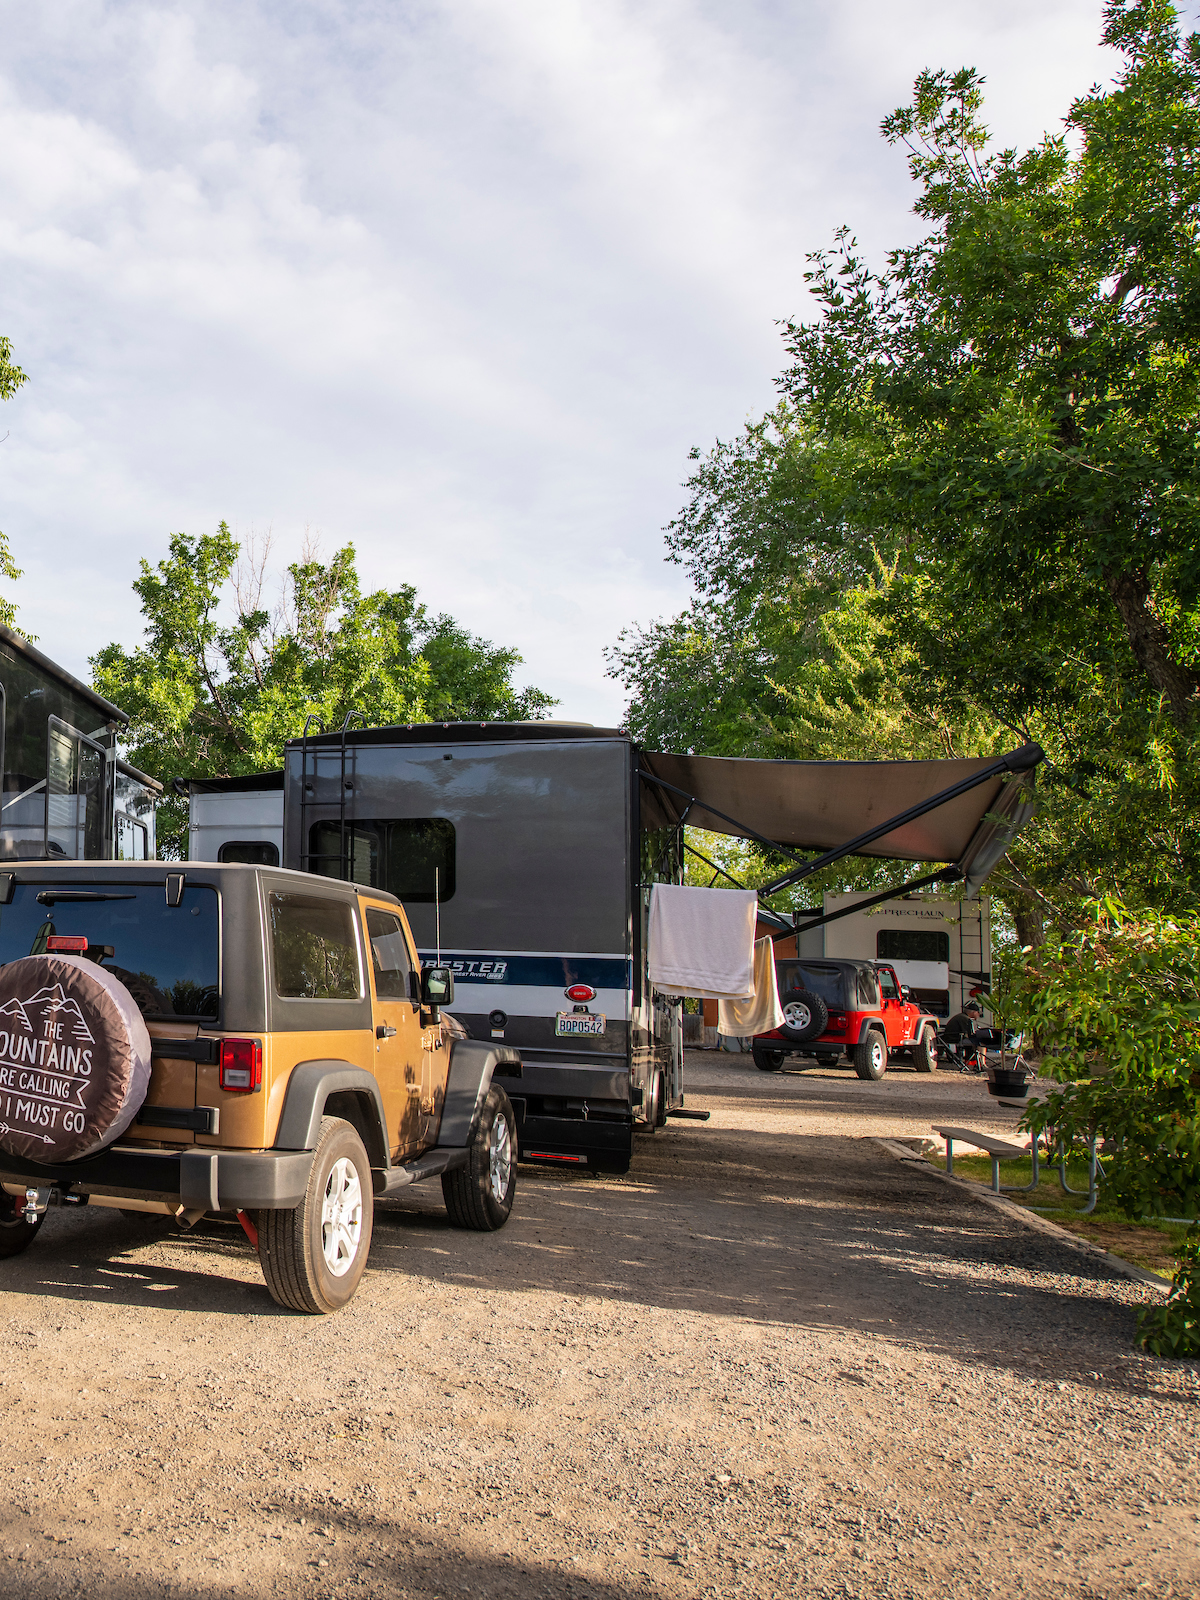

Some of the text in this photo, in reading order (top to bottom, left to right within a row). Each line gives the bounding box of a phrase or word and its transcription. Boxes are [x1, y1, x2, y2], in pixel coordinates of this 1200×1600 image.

[873, 908, 944, 917] EPRECHAUN
[419, 960, 507, 973] RESTER
[43, 1020, 64, 1040] THE
[19, 1072, 70, 1099] CALLING
[5, 1096, 12, 1117] I
[15, 1099, 60, 1128] MUST
[63, 1111, 85, 1134] GO
